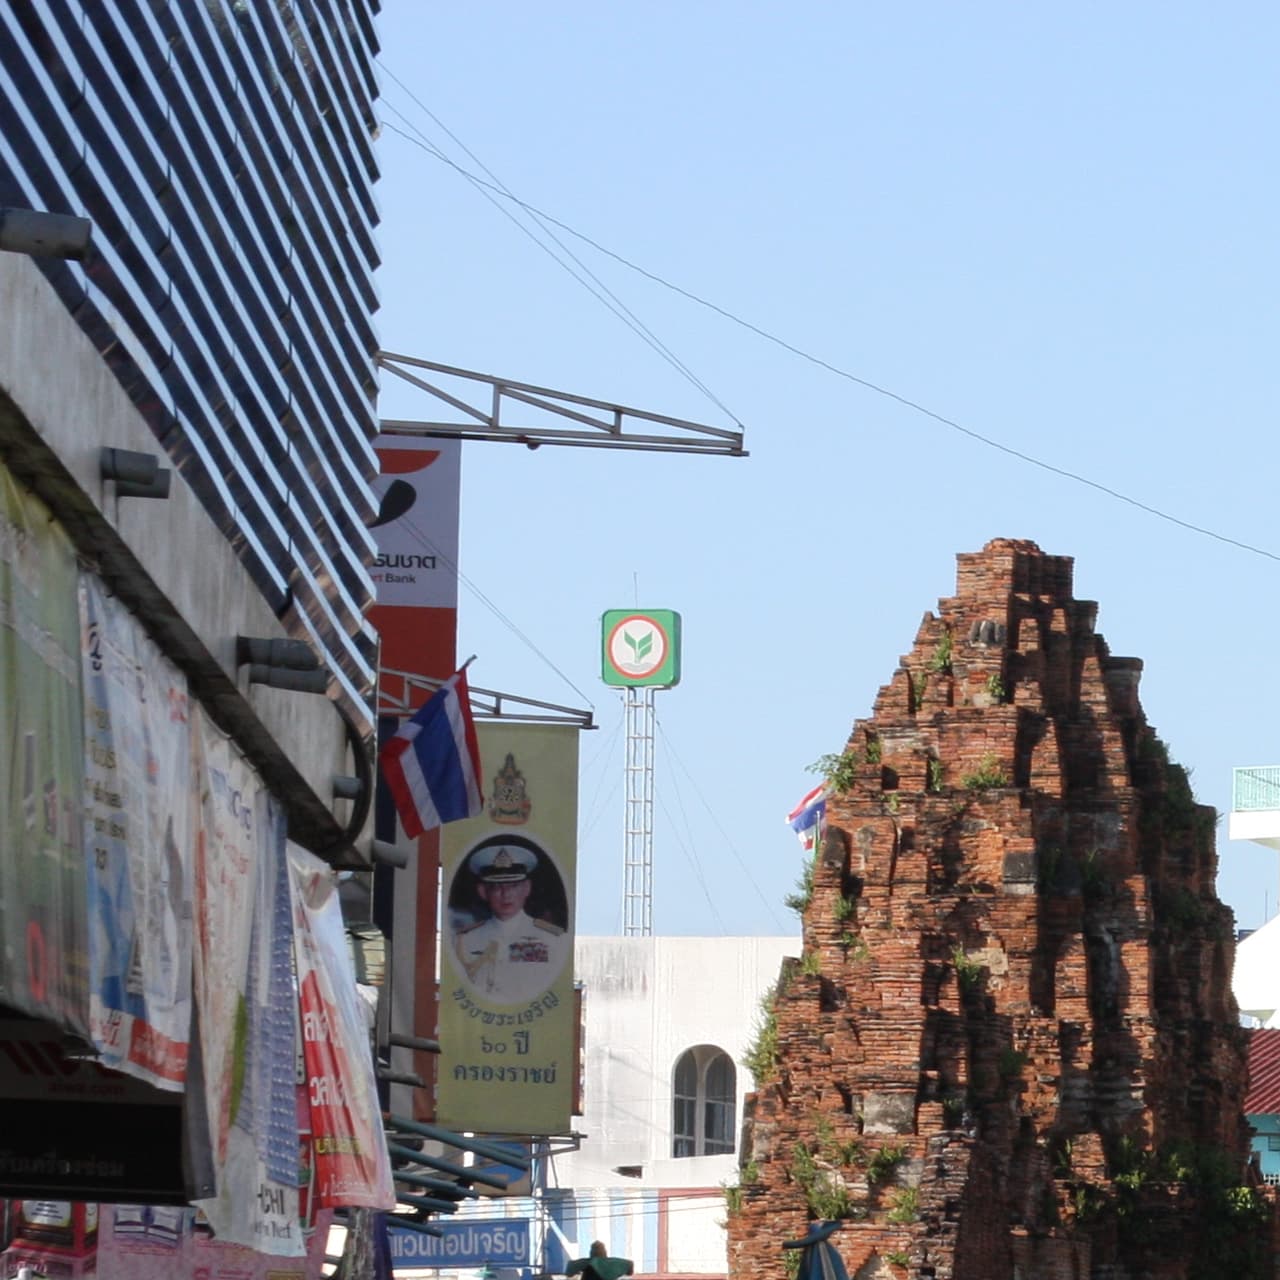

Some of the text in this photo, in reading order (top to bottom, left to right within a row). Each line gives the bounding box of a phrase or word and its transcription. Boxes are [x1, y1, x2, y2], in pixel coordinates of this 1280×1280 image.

[385, 573, 416, 584] Bank
[512, 1030, 530, 1055] ปี
[453, 1061, 558, 1084] ครองราชย์
